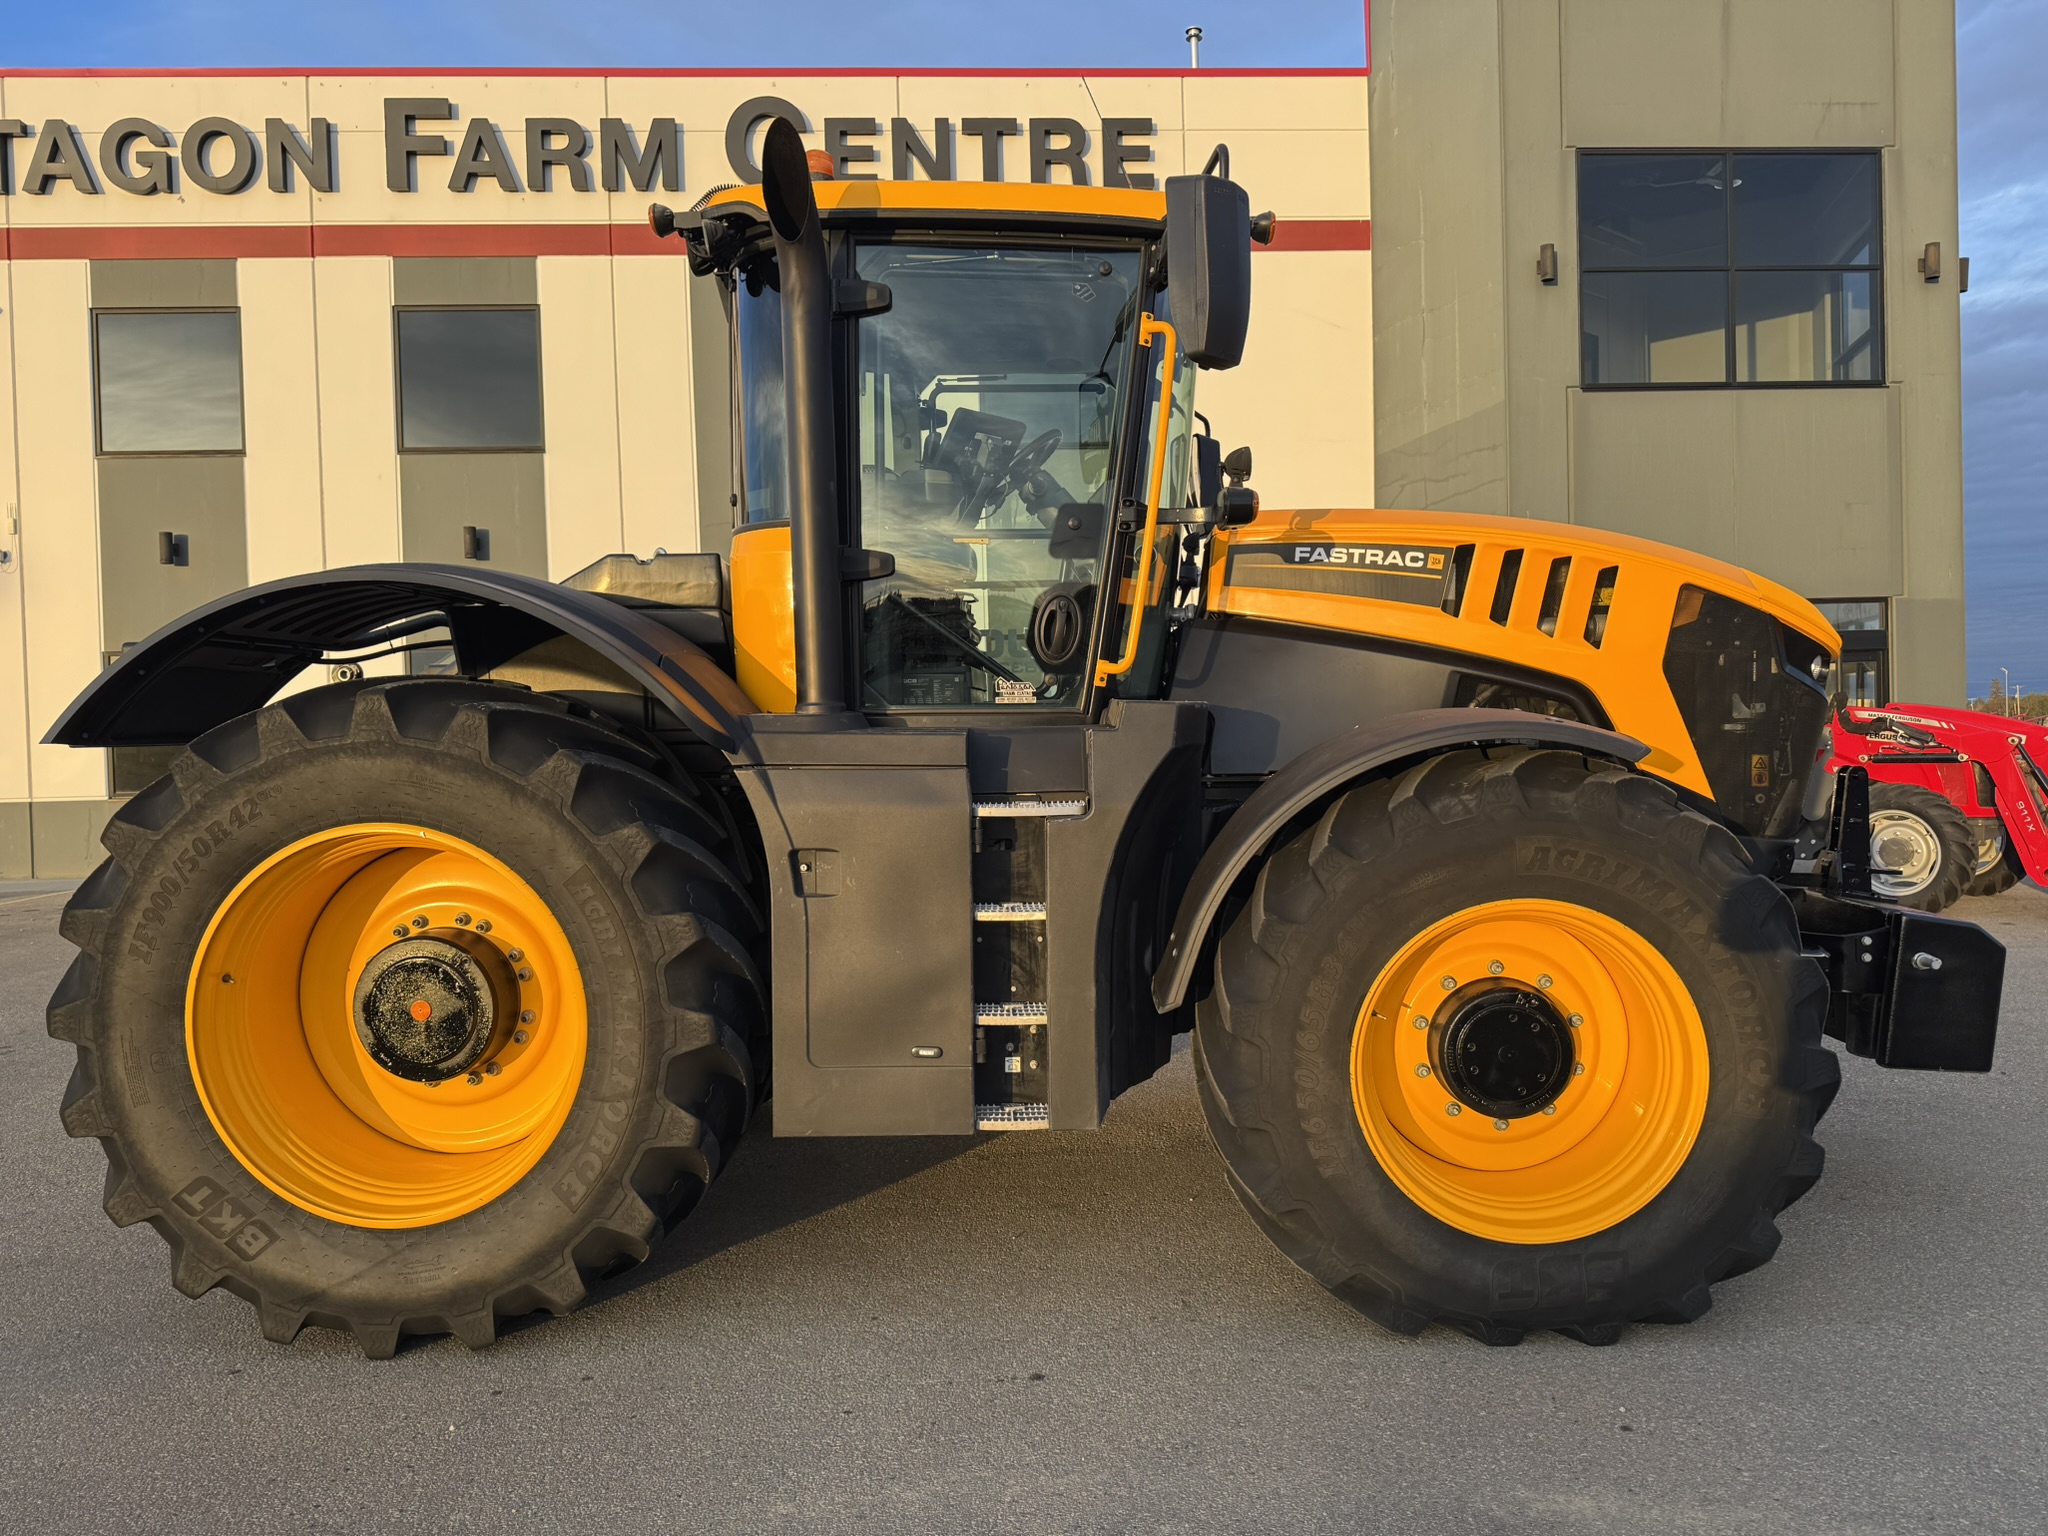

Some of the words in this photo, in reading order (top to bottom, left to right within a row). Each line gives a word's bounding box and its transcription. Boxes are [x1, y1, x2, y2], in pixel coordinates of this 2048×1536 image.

[384, 98, 678, 193] FARM
[725, 96, 1157, 189] CENTRE
[1294, 546, 1424, 568] FASTRAC
[1892, 714, 1922, 723] FERGUSON
[2015, 800, 2036, 832] 911X
[180, 1185, 271, 1257] BKT
